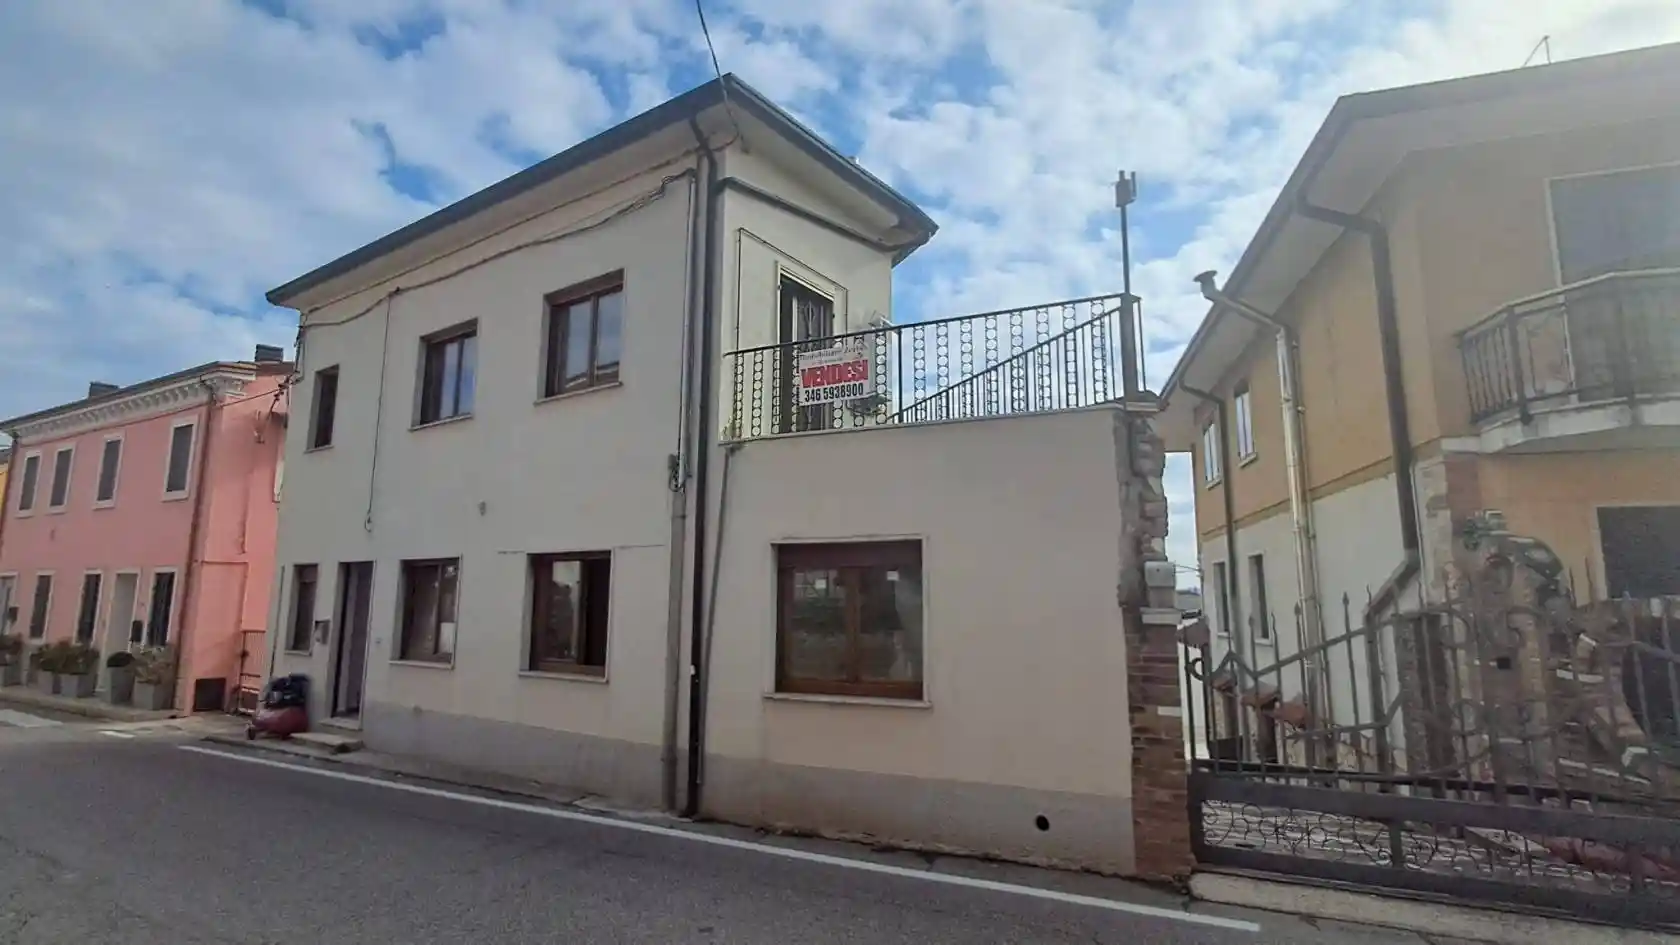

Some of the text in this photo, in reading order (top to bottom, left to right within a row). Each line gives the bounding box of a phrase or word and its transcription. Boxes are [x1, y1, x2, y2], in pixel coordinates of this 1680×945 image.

[800, 360, 868, 388] VENDESI
[805, 383, 864, 402] 346 5938900
